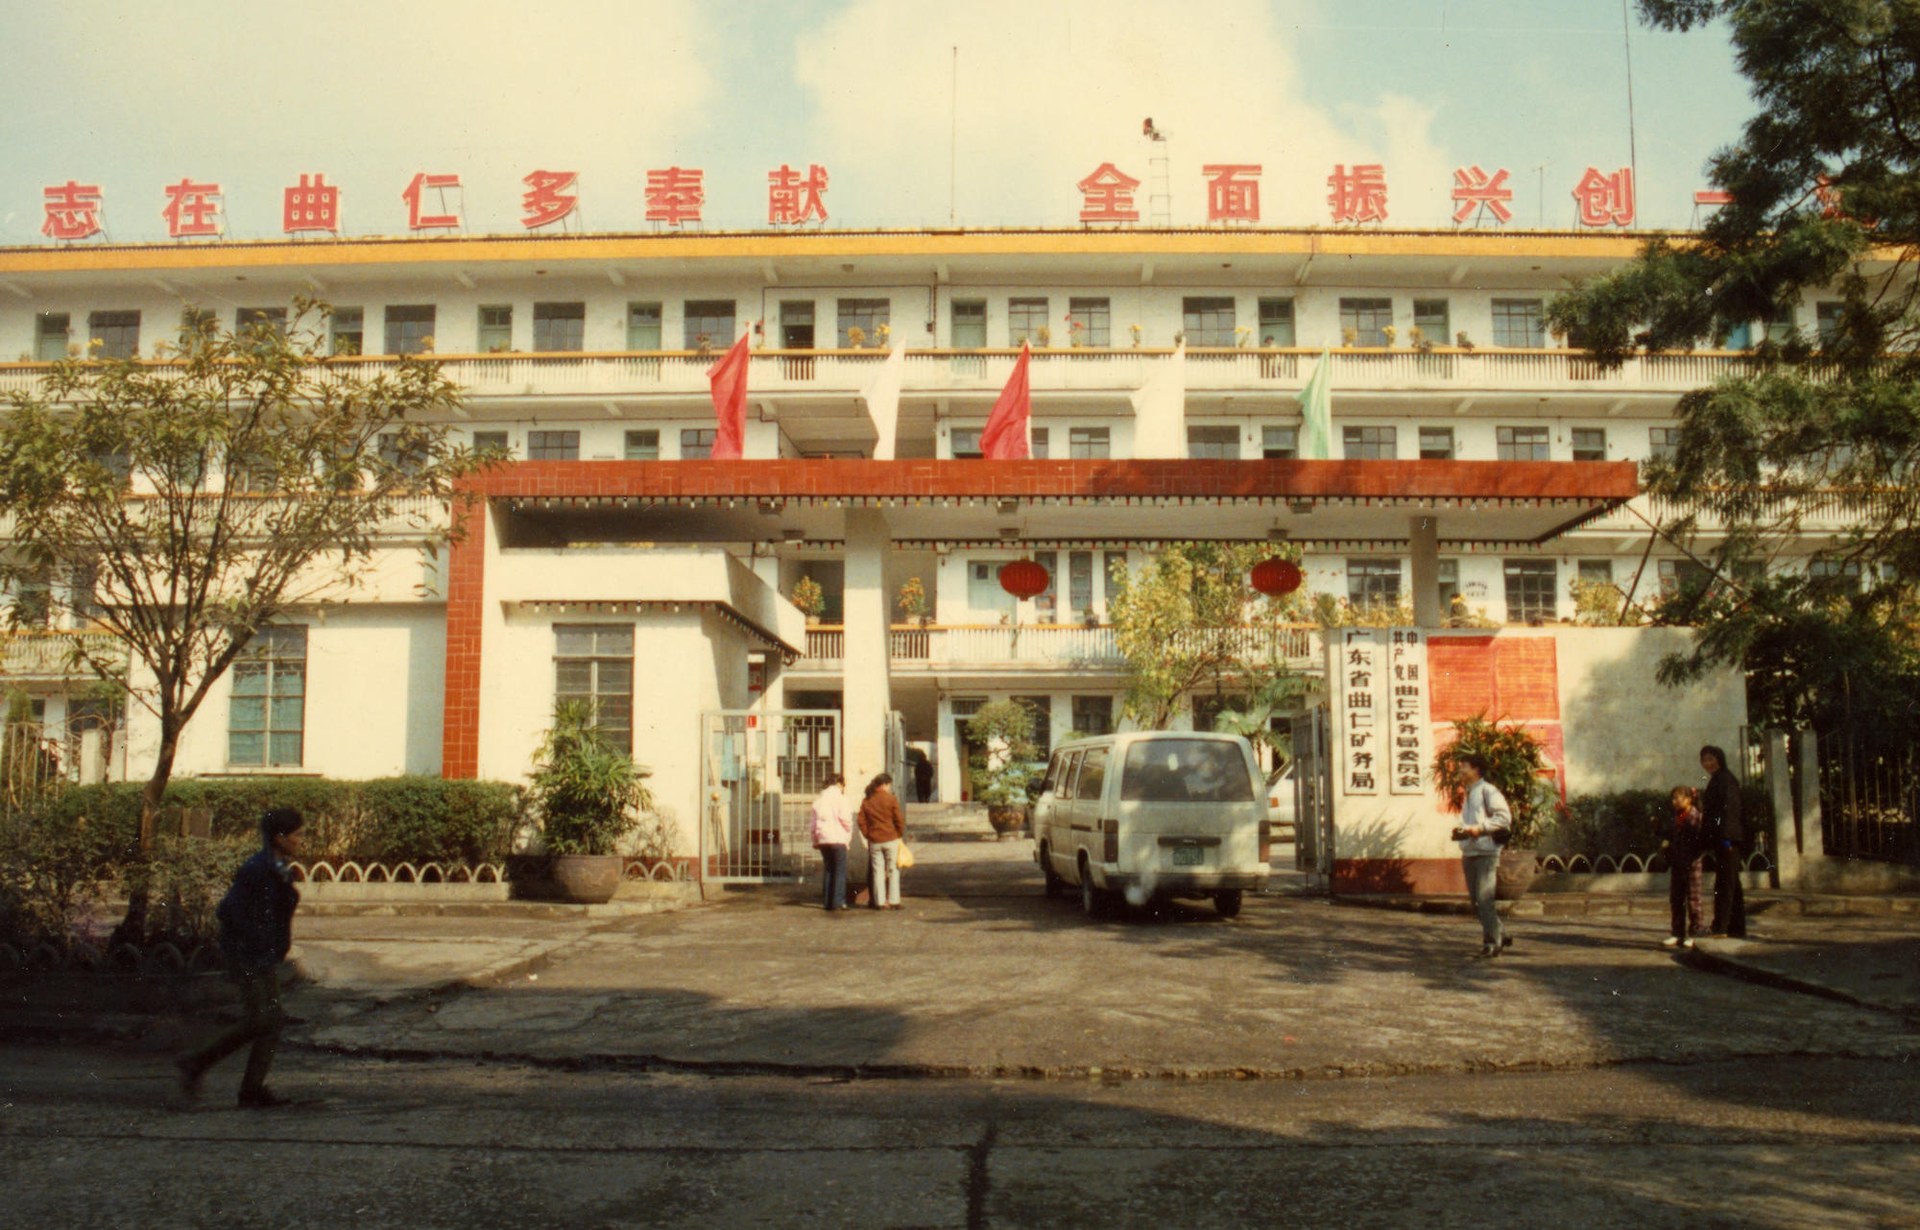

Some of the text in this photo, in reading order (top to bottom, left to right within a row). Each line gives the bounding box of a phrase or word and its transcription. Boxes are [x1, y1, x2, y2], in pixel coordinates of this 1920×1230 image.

[42, 164, 830, 240] 志在曲仁多奉献
[1078, 163, 1882, 230] 全面振兴创一
[1346, 630, 1375, 790] 广东省曲仁矿务局
